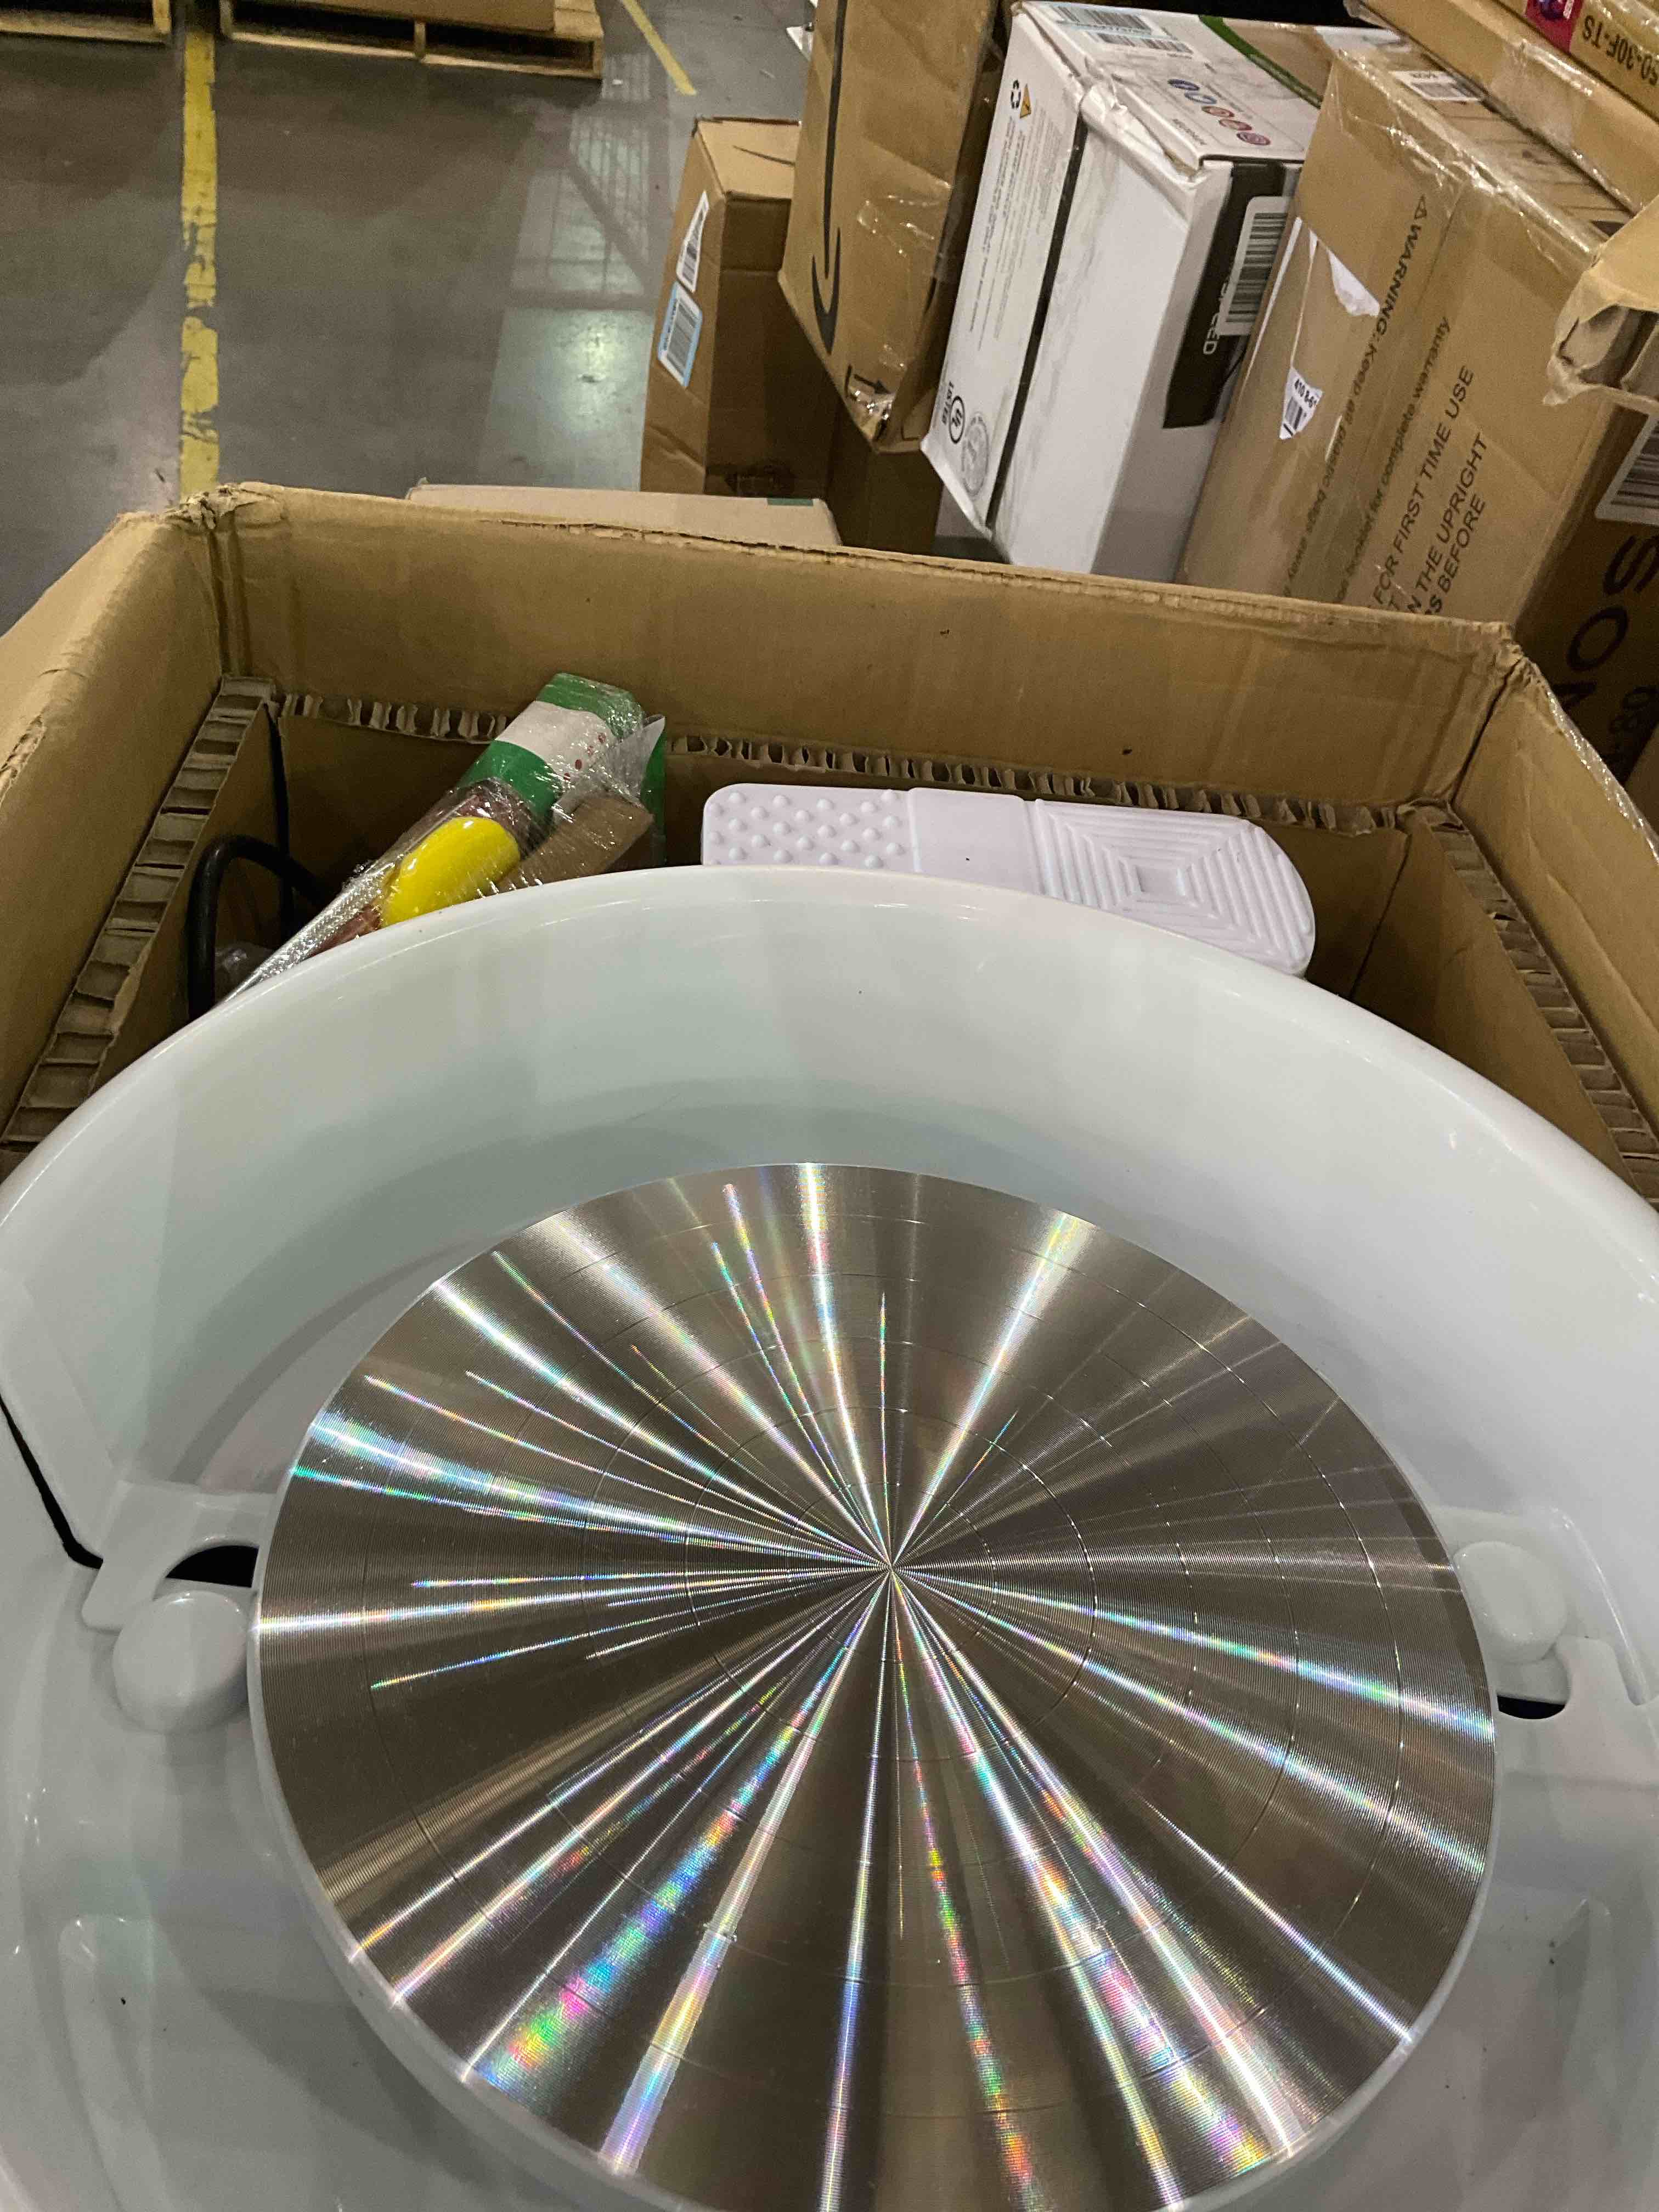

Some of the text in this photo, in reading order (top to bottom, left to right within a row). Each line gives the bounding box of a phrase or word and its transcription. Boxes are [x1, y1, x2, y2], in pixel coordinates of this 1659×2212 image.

[1373, 224, 1421, 342] WARNING:
[1353, 343, 1377, 396] Keep
[1381, 403, 1415, 486] complete
[1413, 317, 1451, 399] warranty
[1373, 365, 1474, 605] FOR FIRST TIME USE
[1415, 546, 1443, 592] THE
[1437, 432, 1487, 544] UPRIGHT
[1438, 494, 1486, 593] BEFORE
